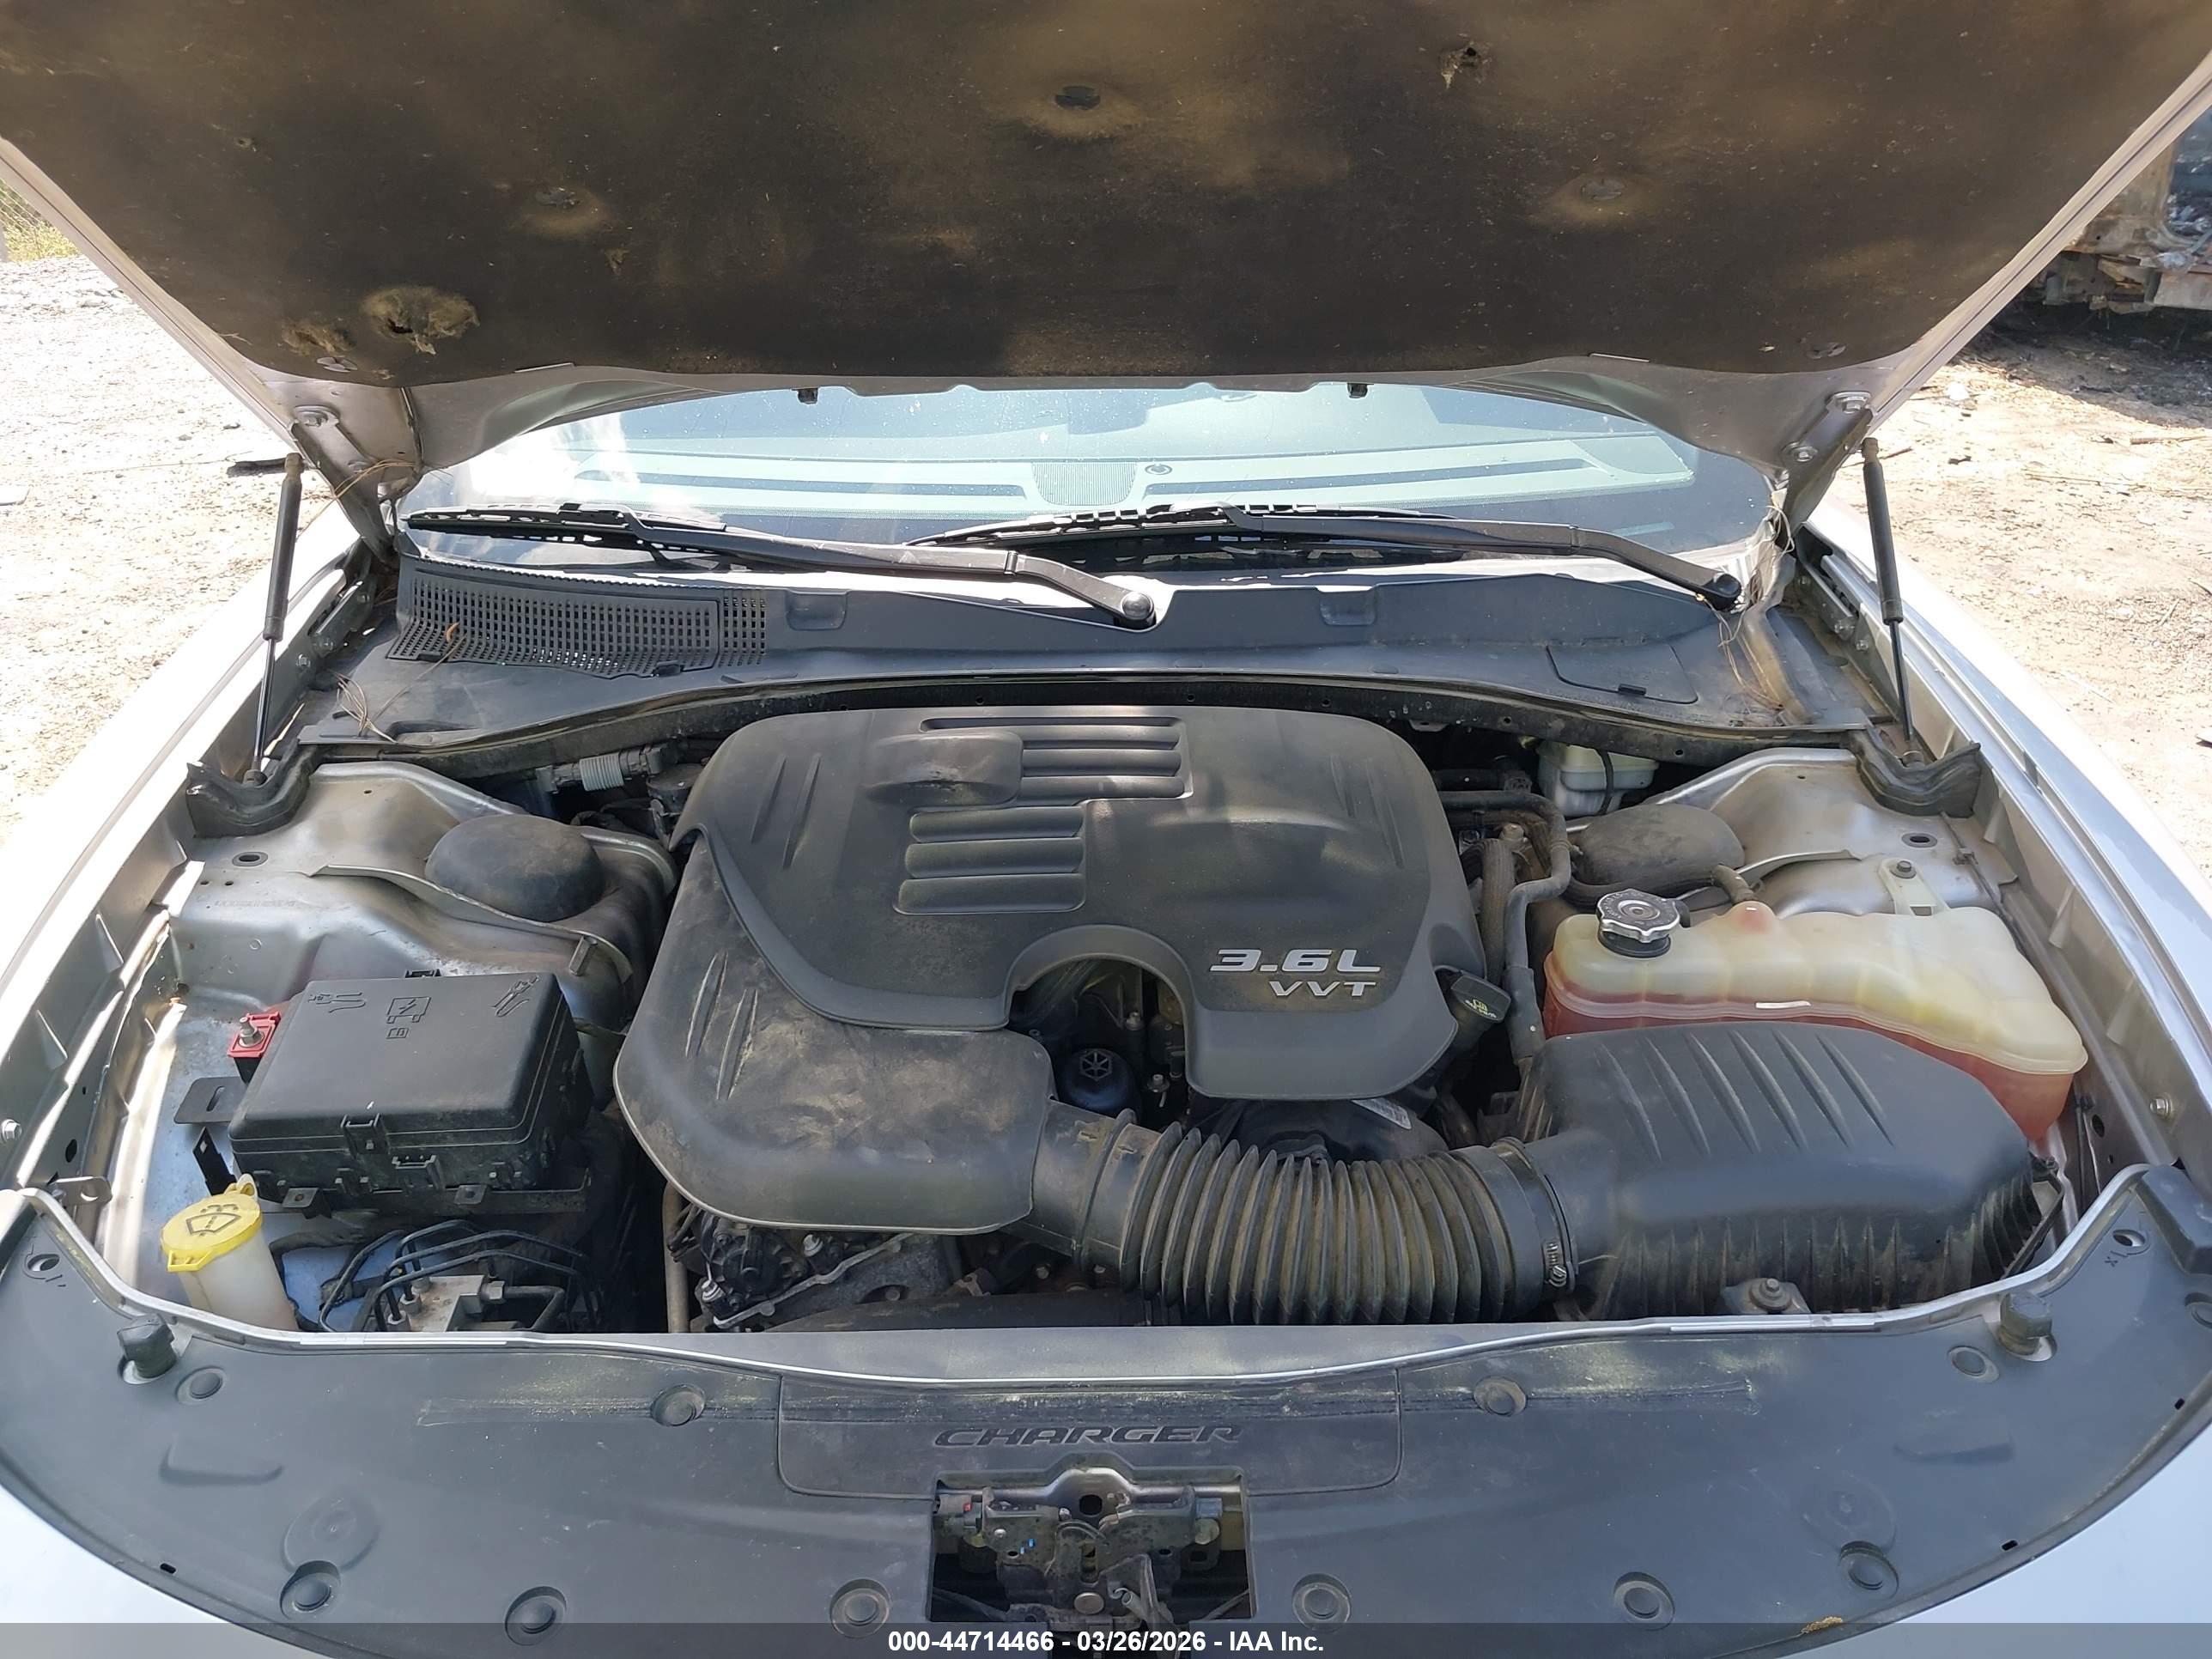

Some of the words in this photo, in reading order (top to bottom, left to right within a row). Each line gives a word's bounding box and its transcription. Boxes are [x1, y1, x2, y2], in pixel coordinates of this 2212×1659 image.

[1209, 949, 1382, 973] 3.6L
[1267, 981, 1377, 998] VVT
[934, 1425, 1243, 1447] CHARGER
